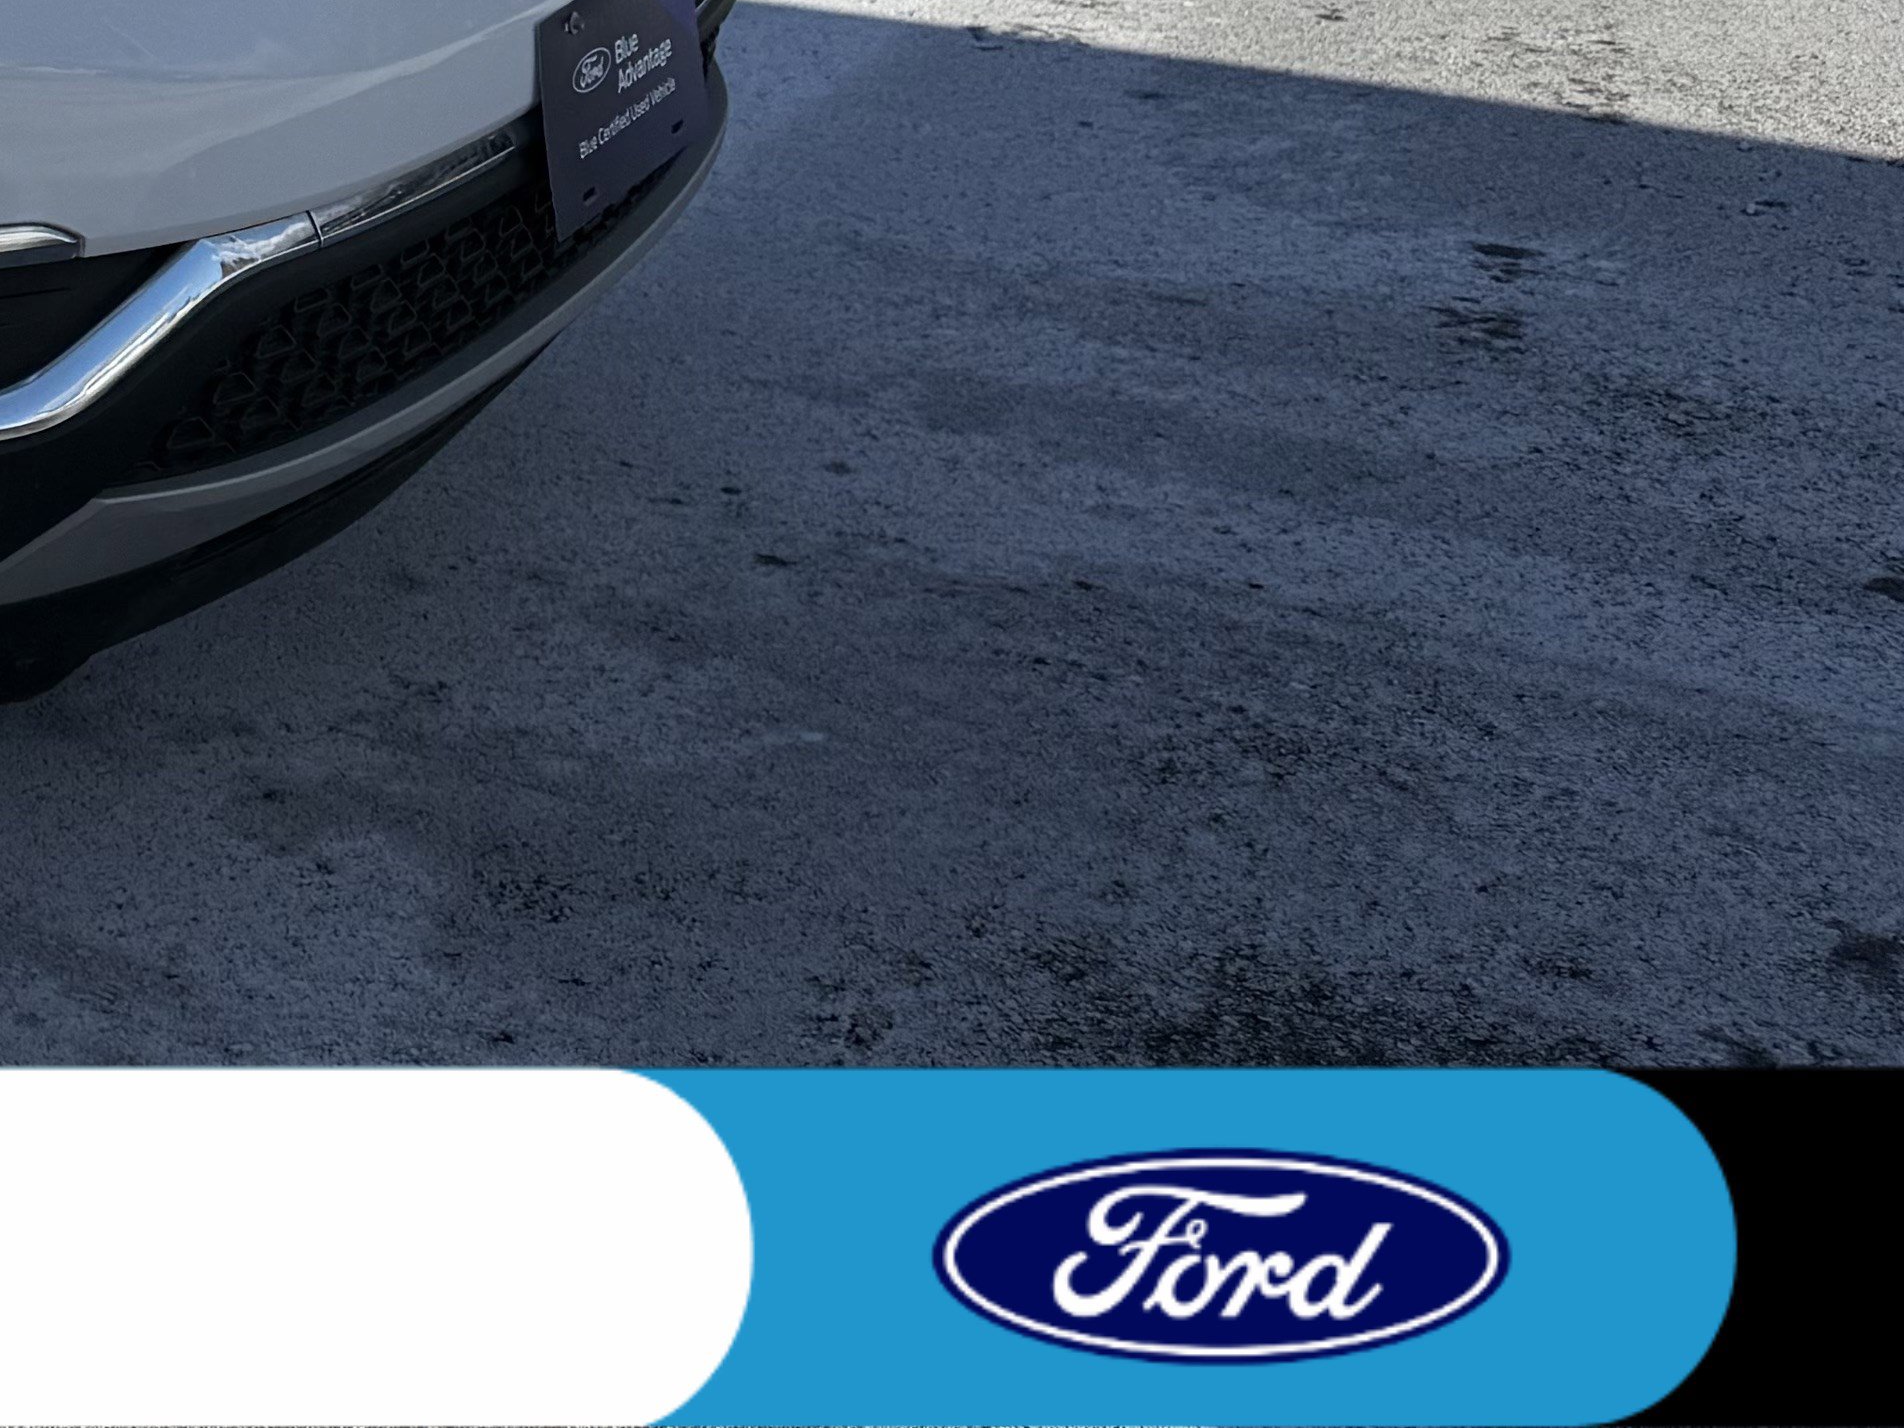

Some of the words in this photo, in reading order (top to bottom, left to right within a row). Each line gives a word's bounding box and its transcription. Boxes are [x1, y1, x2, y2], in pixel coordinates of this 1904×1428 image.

[614, 33, 640, 64] Blue
[617, 38, 673, 94] Advantage
[579, 136, 598, 159] Blue
[598, 108, 632, 145] Certified
[630, 94, 651, 121] Used
[649, 77, 676, 106] Vehicle
